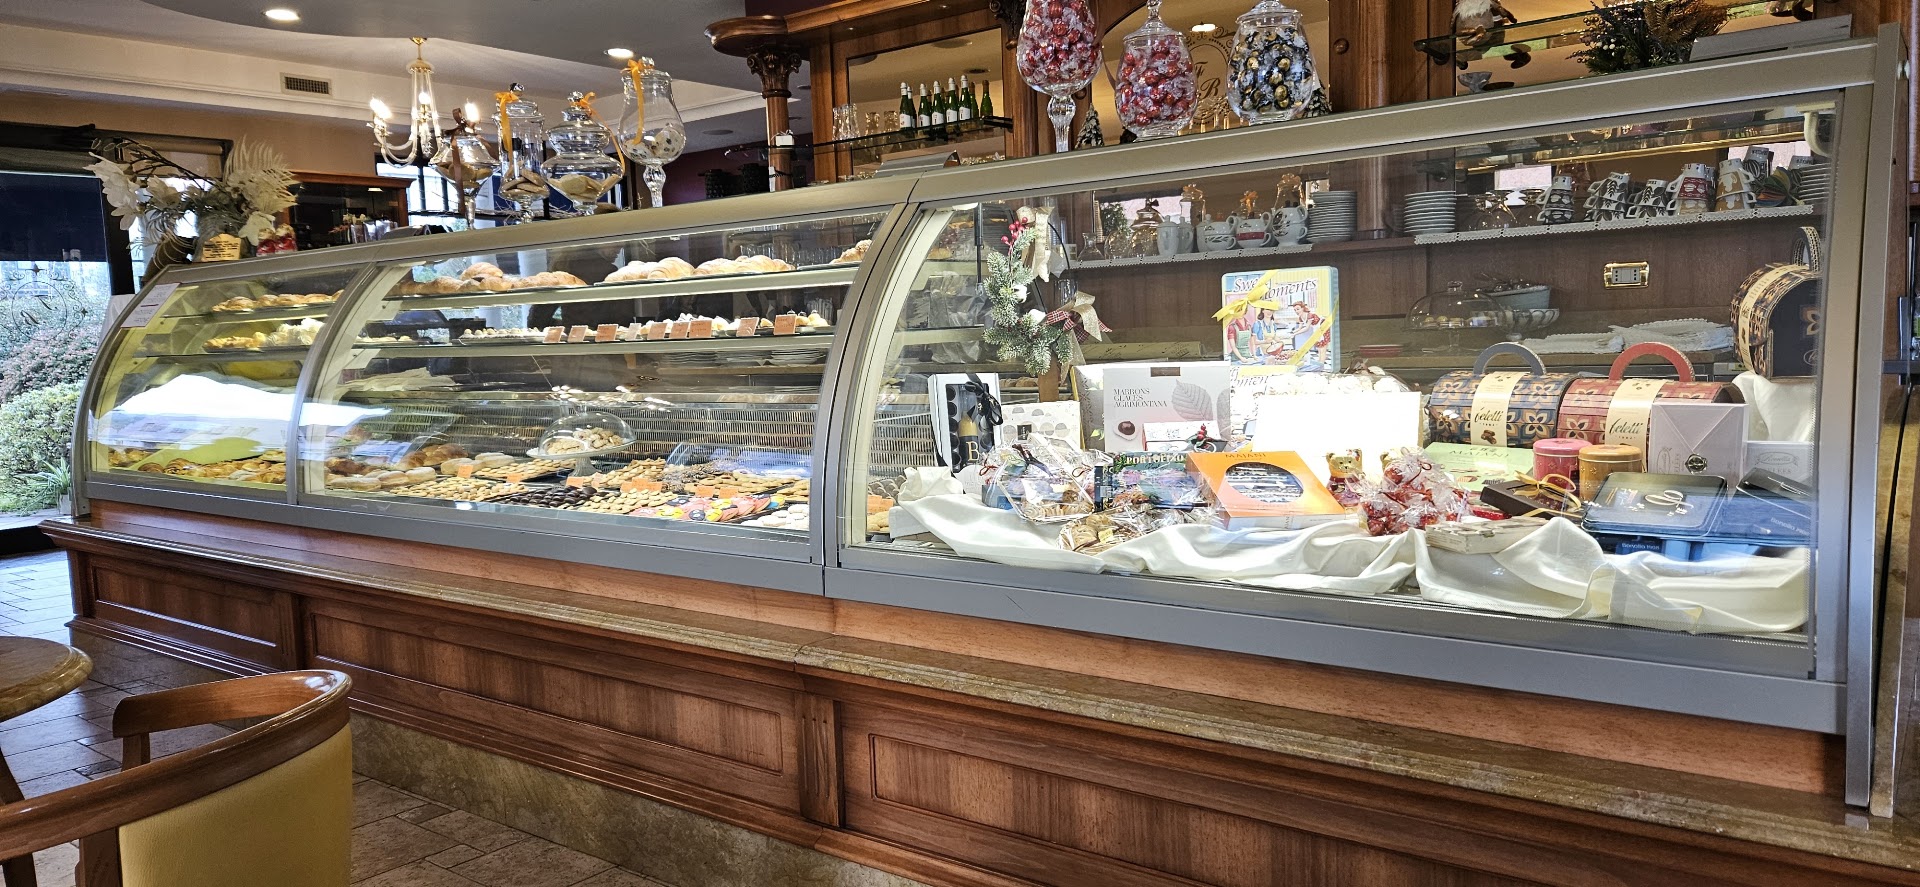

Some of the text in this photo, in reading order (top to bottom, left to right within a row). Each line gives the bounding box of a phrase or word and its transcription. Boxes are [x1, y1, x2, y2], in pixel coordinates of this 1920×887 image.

[1233, 278, 1264, 293] Swe
[1113, 388, 1150, 396] MARRONS
[1113, 400, 1168, 408] AGRIMONTANA
